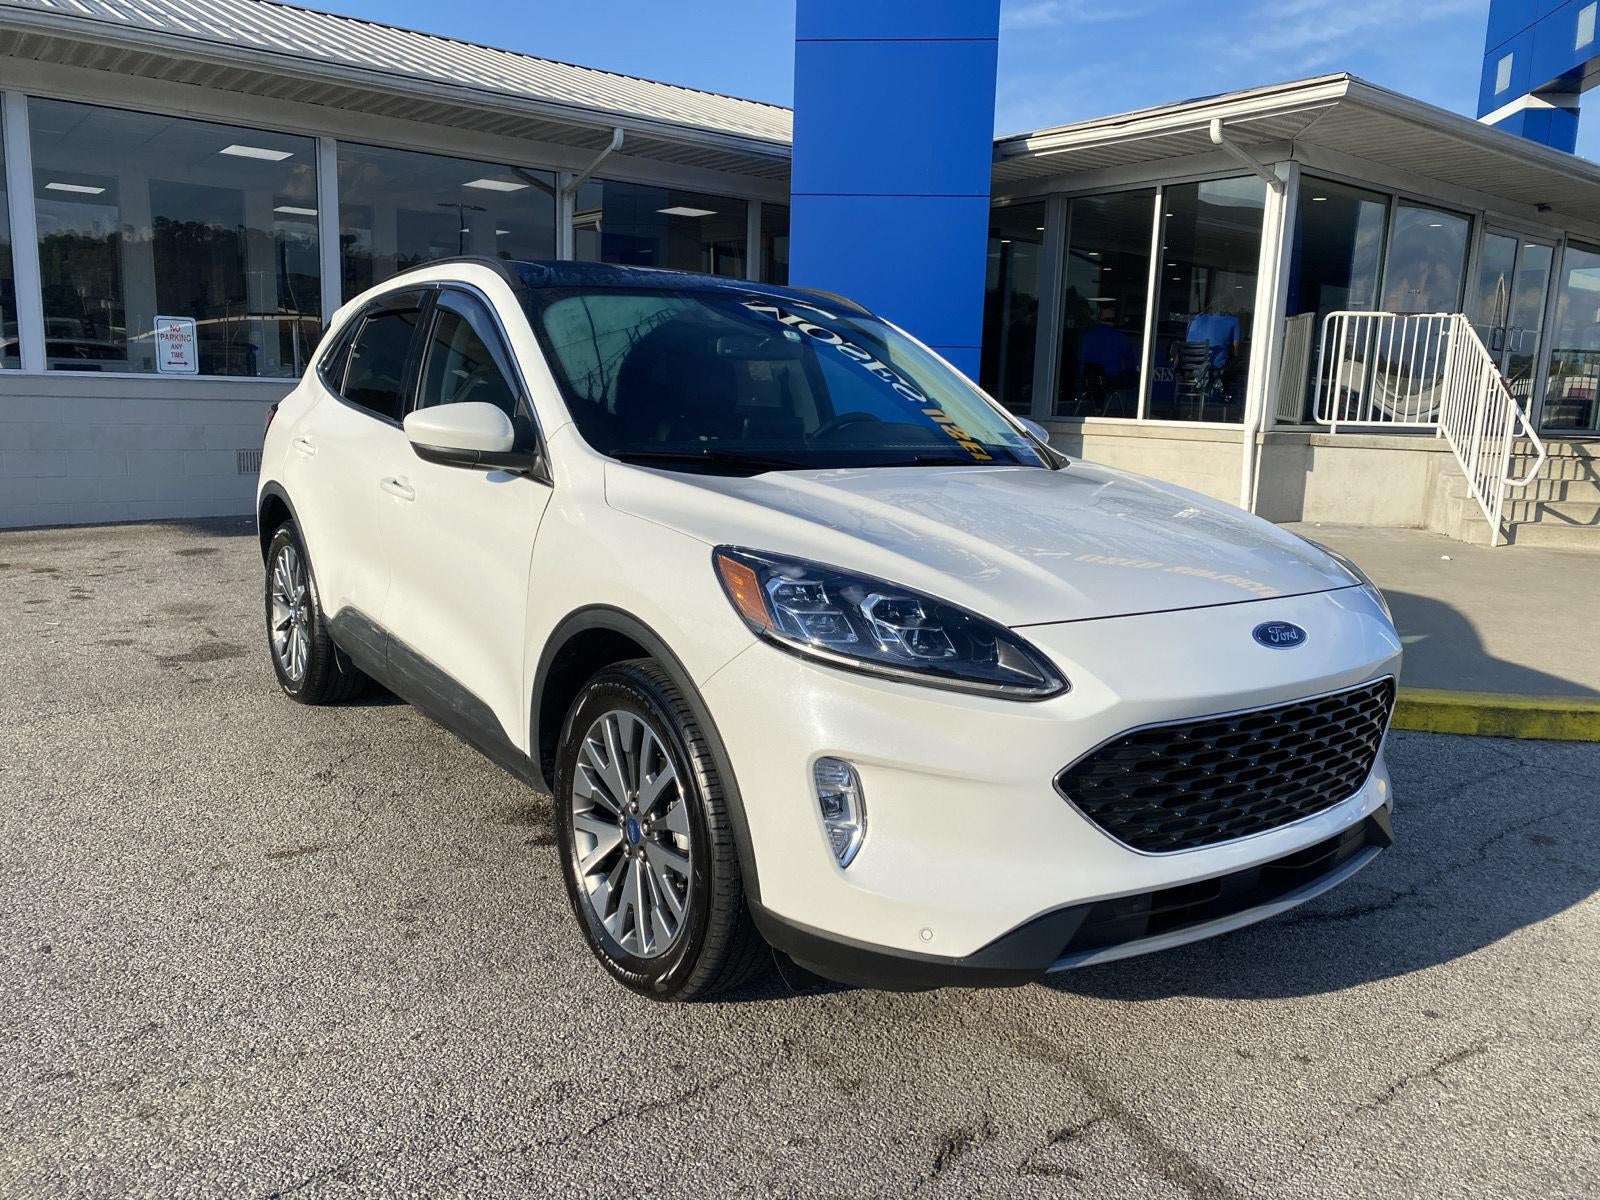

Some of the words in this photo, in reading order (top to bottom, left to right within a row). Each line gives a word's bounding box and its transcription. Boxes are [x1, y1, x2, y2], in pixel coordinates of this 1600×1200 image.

[170, 324, 181, 332] NO
[160, 333, 192, 342] PARKING
[1268, 625, 1299, 643] Ford
